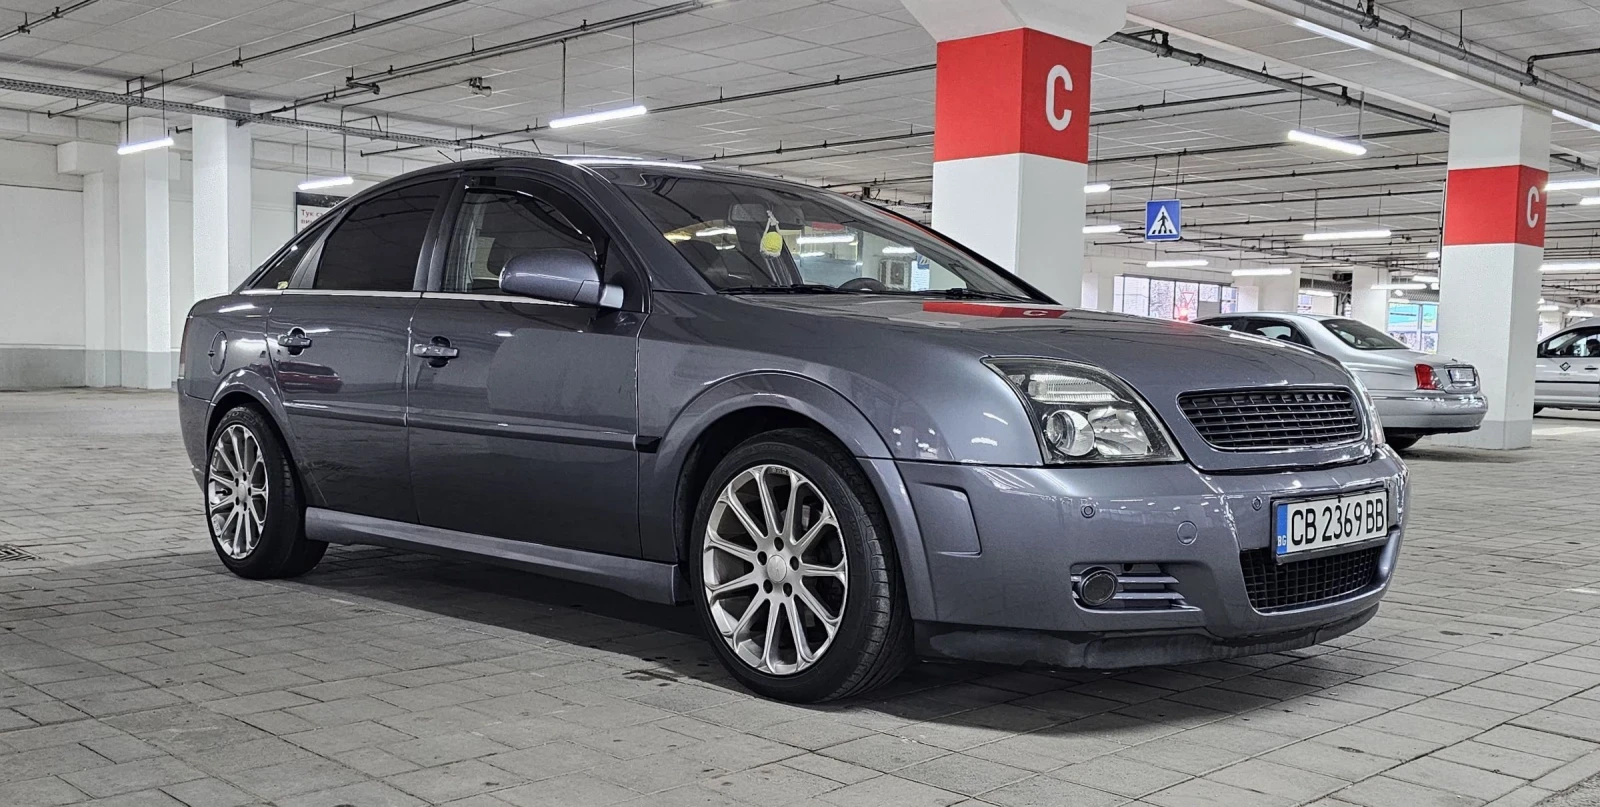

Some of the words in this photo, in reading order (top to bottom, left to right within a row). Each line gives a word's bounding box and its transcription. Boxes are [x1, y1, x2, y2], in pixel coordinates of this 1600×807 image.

[1046, 64, 1073, 134] C
[301, 209, 314, 218] Тук
[1526, 185, 1539, 228] C
[1277, 535, 1287, 547] BG
[1291, 508, 1317, 546] CB
[1322, 502, 1363, 542] 2369
[1366, 498, 1385, 534] BB
